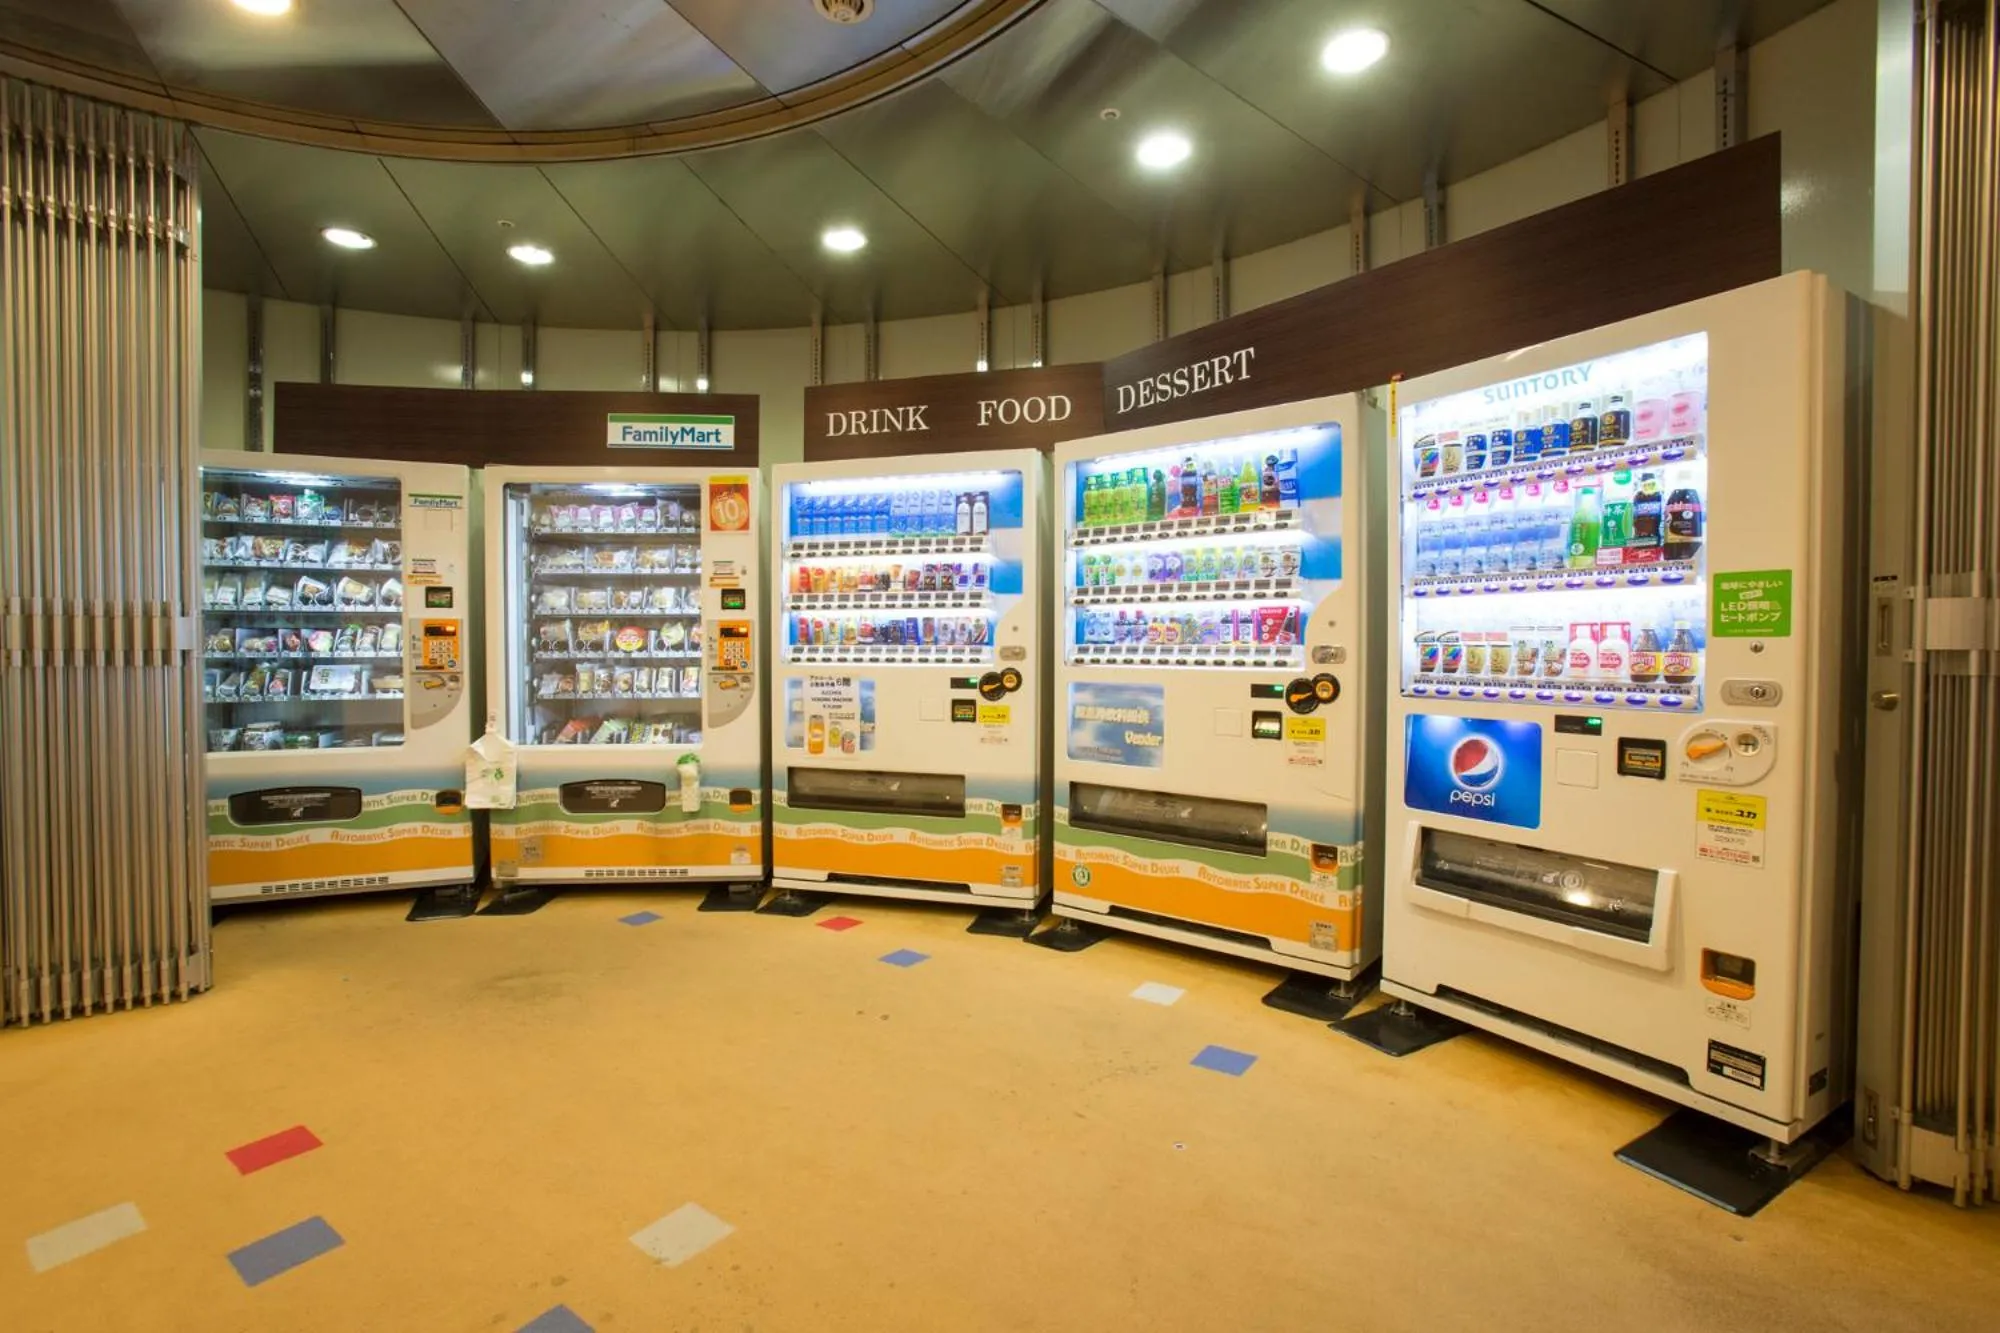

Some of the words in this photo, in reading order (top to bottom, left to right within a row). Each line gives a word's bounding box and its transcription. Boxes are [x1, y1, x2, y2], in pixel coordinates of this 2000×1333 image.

[1116, 347, 1255, 414] DESSERT
[1484, 362, 1594, 405] SUNTORY
[826, 405, 929, 437] DRINK
[977, 394, 1072, 426] FOOD
[622, 425, 721, 444] FamilyMart
[414, 498, 457, 508] FamilyMart
[1720, 611, 1781, 623] ヒートポンプ
[1450, 790, 1495, 807] pepsi
